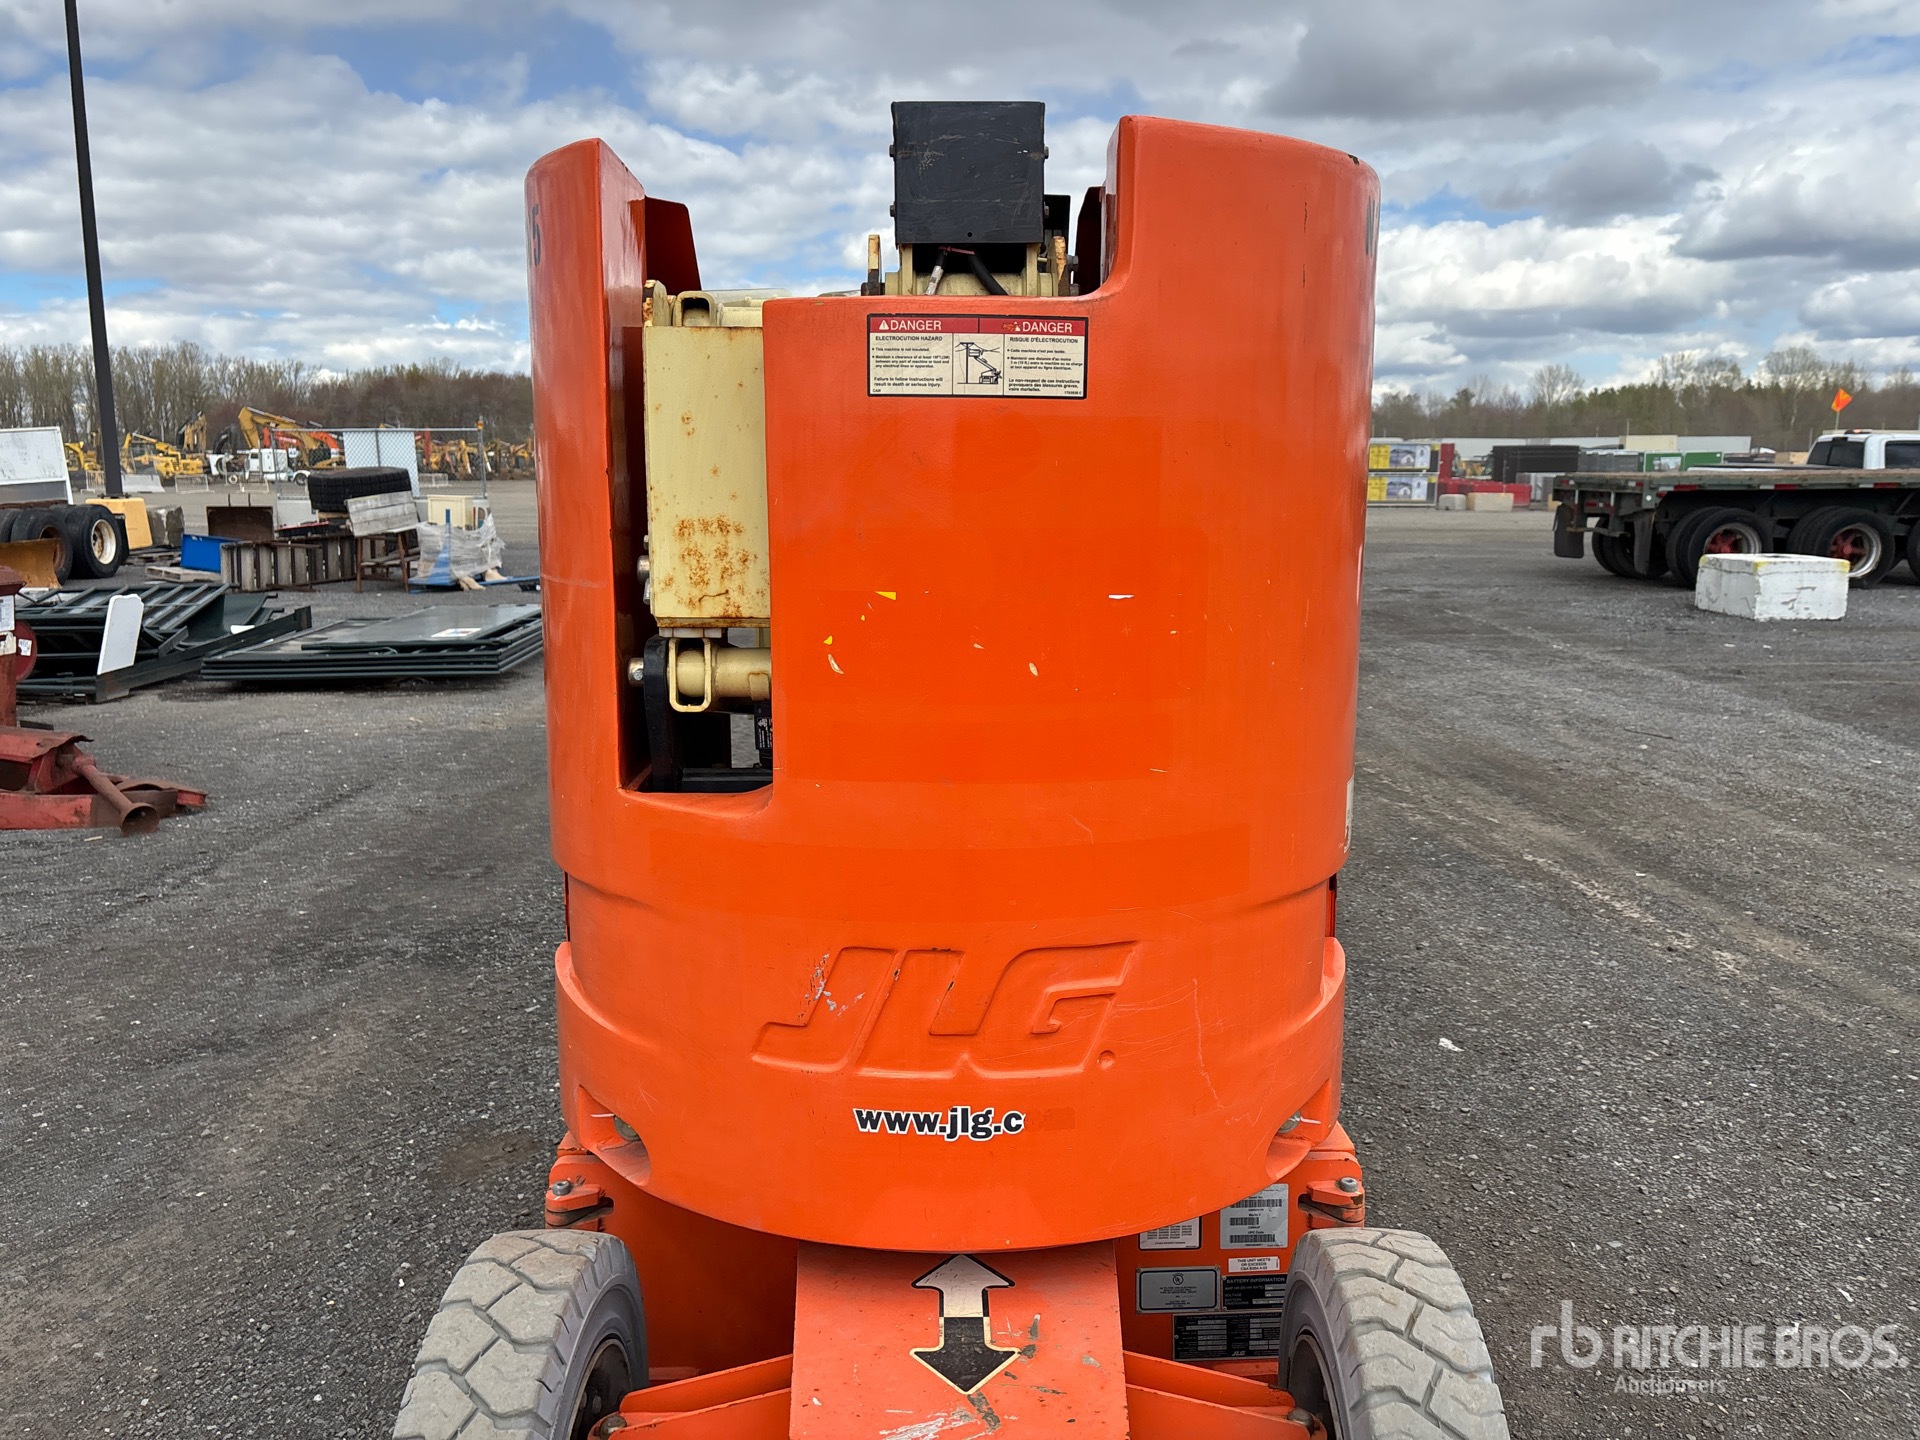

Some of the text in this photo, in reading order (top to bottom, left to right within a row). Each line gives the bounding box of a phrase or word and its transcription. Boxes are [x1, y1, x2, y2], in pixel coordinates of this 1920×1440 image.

[890, 320, 941, 330] DANGER
[1023, 322, 1072, 333] DANGER
[752, 941, 1139, 1080] JLG
